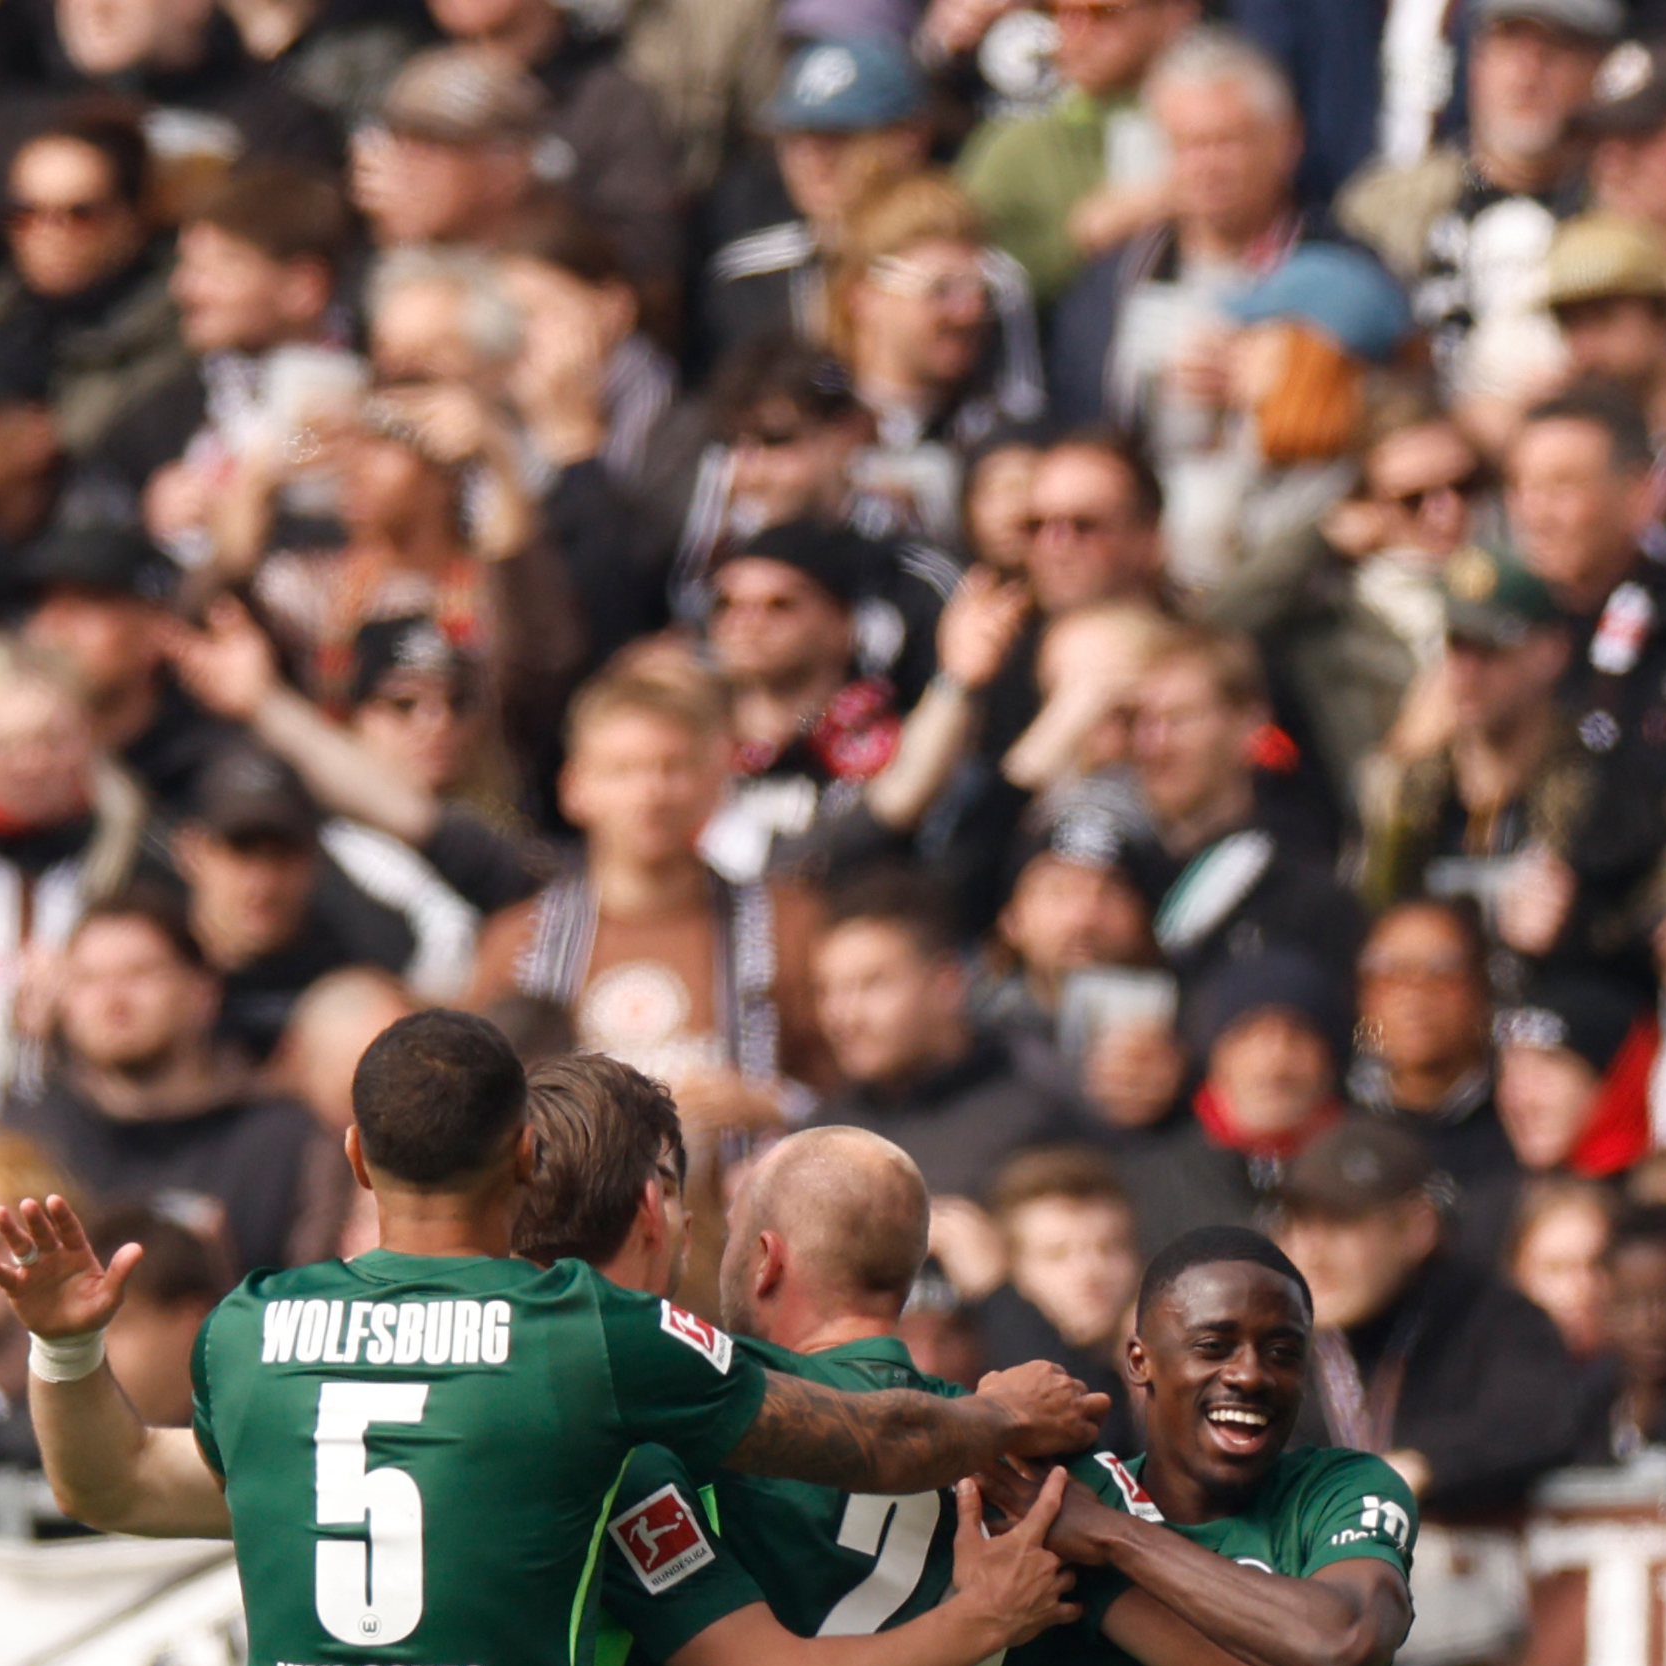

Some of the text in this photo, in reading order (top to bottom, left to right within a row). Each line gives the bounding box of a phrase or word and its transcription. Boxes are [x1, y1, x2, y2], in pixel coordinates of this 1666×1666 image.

[261, 1298, 512, 1364] WOLFSBURG
[313, 1381, 430, 1646] 5
[650, 1546, 708, 1586] BUNDESLIGA
